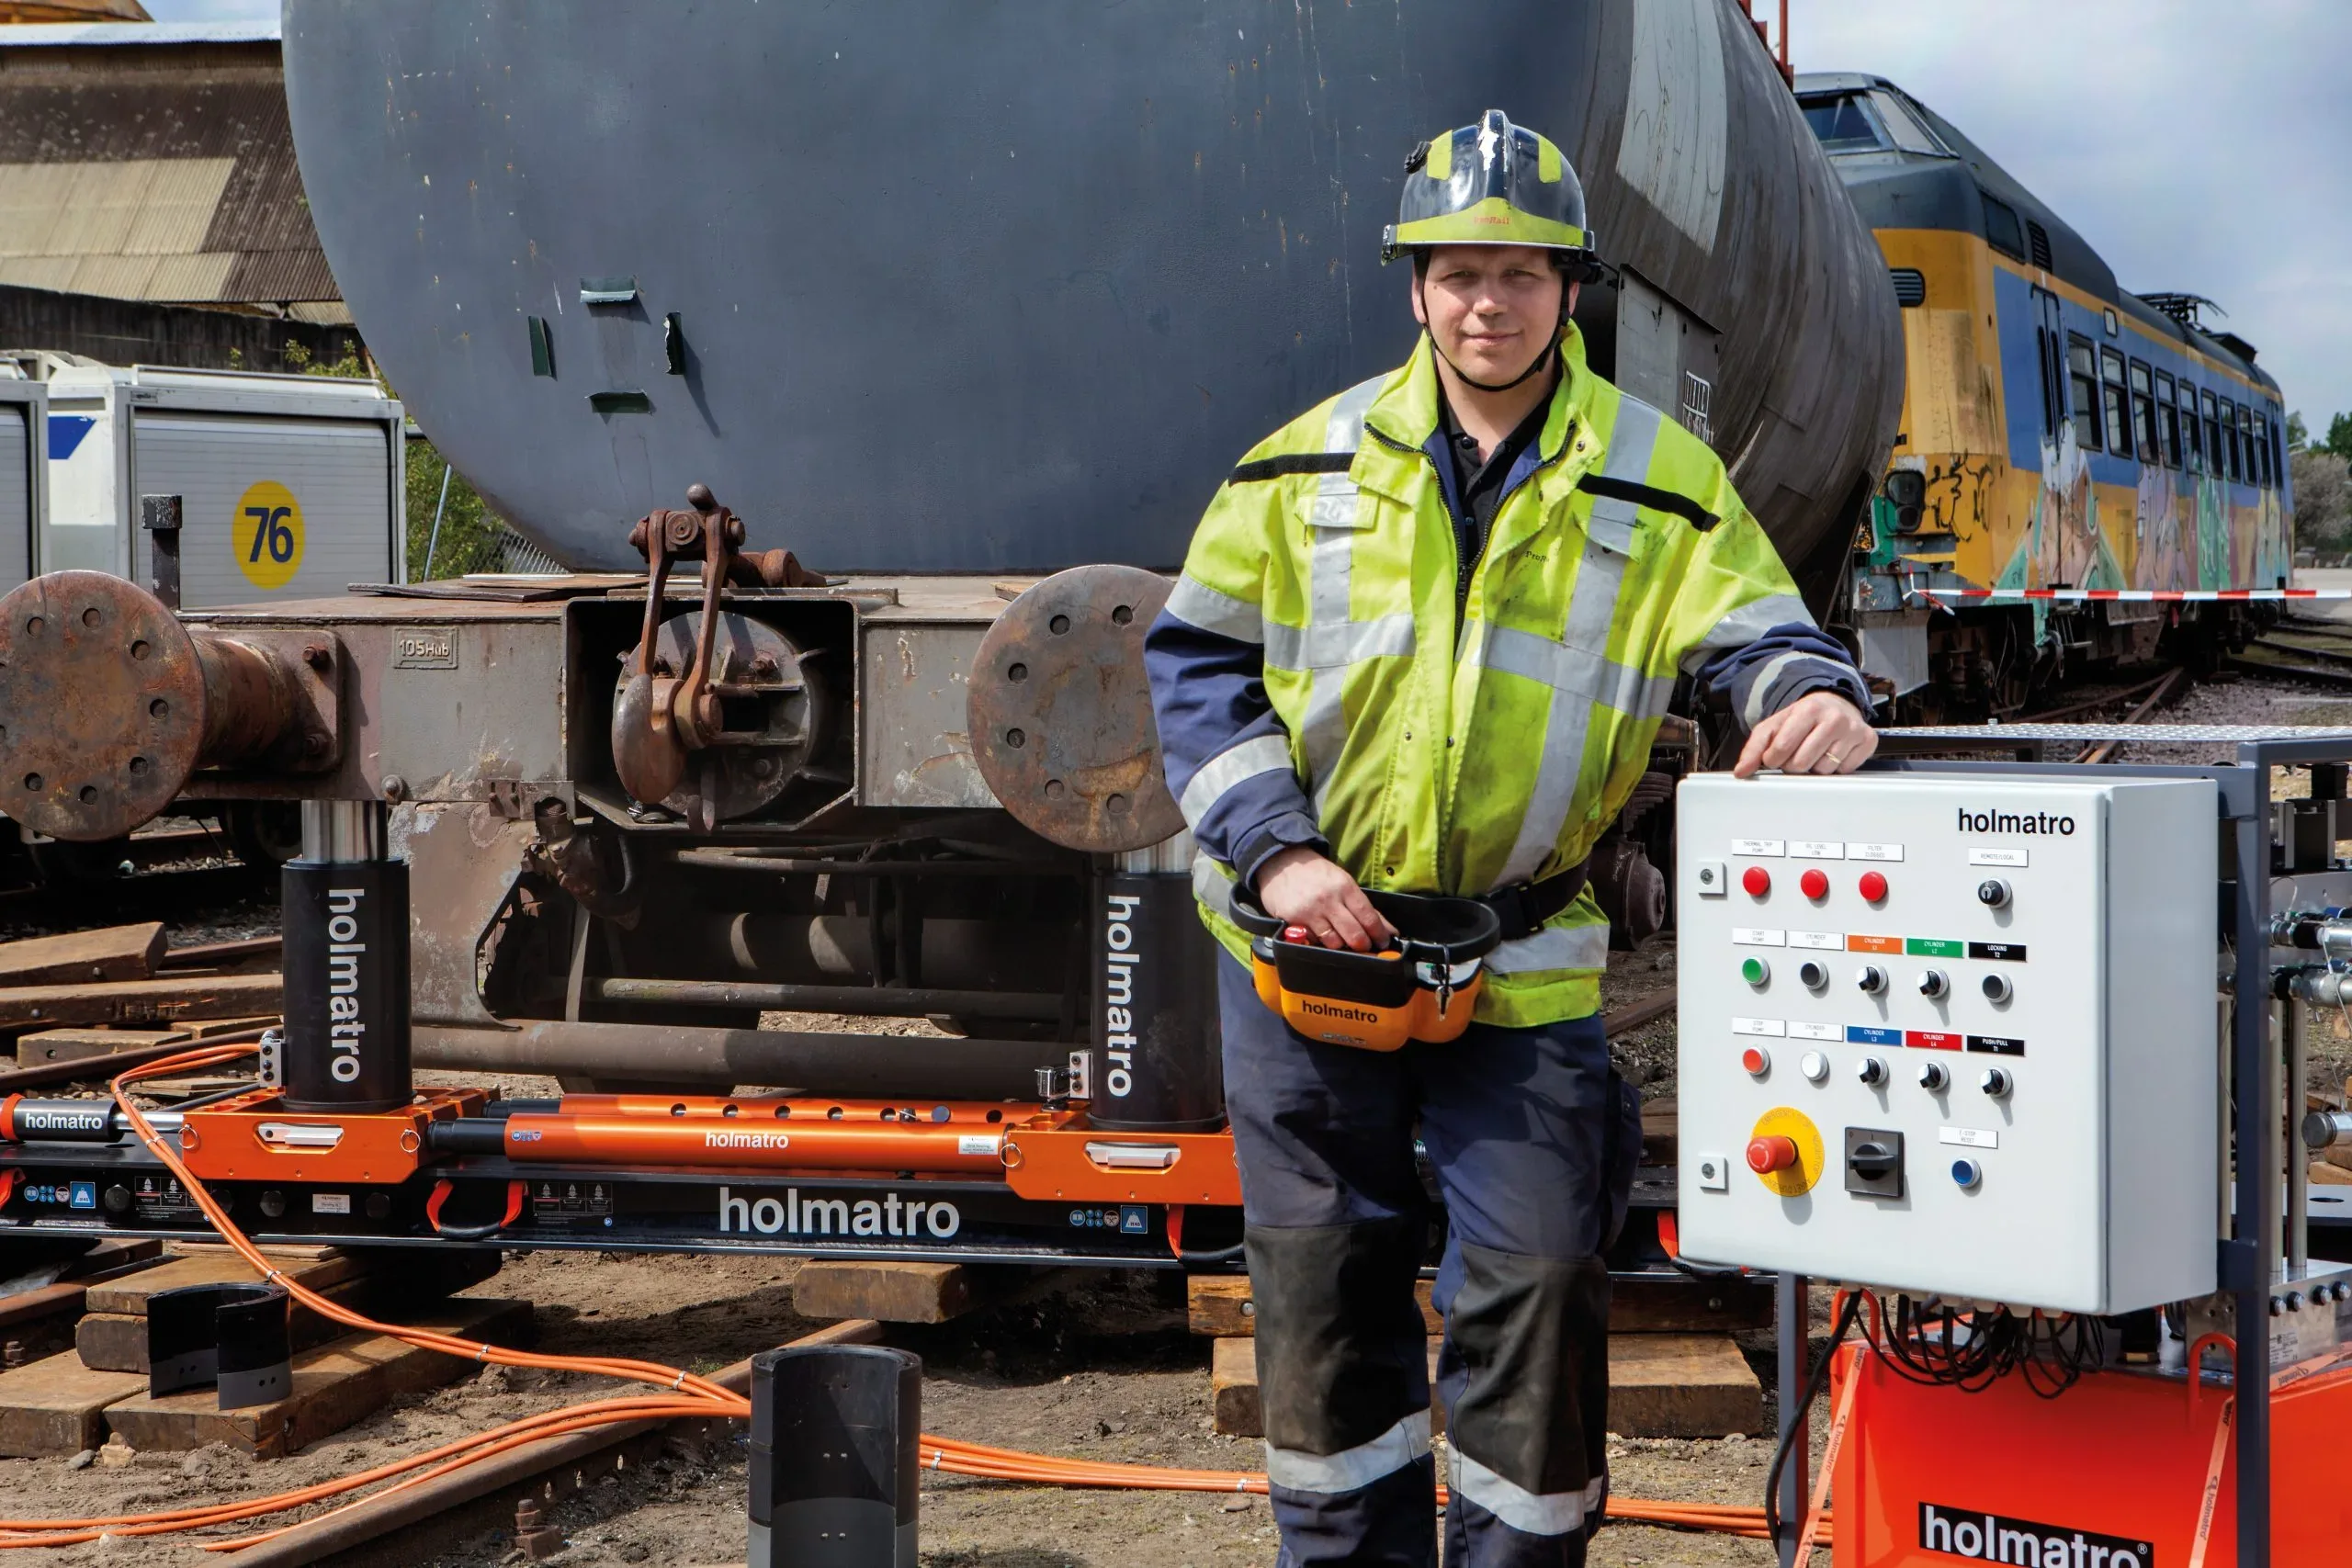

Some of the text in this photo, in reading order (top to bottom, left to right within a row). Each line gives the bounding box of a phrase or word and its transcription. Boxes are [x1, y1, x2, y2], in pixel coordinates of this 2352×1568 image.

[245, 506, 294, 563] 76
[1958, 807, 2075, 836] holmatro
[328, 888, 367, 1082] holmatro
[1107, 895, 1140, 1097] holmatro
[1302, 1000, 1378, 1023] holmatro
[25, 1112, 103, 1130] holmatro
[706, 1132, 789, 1149] holmatro
[719, 1187, 960, 1238] holmatro
